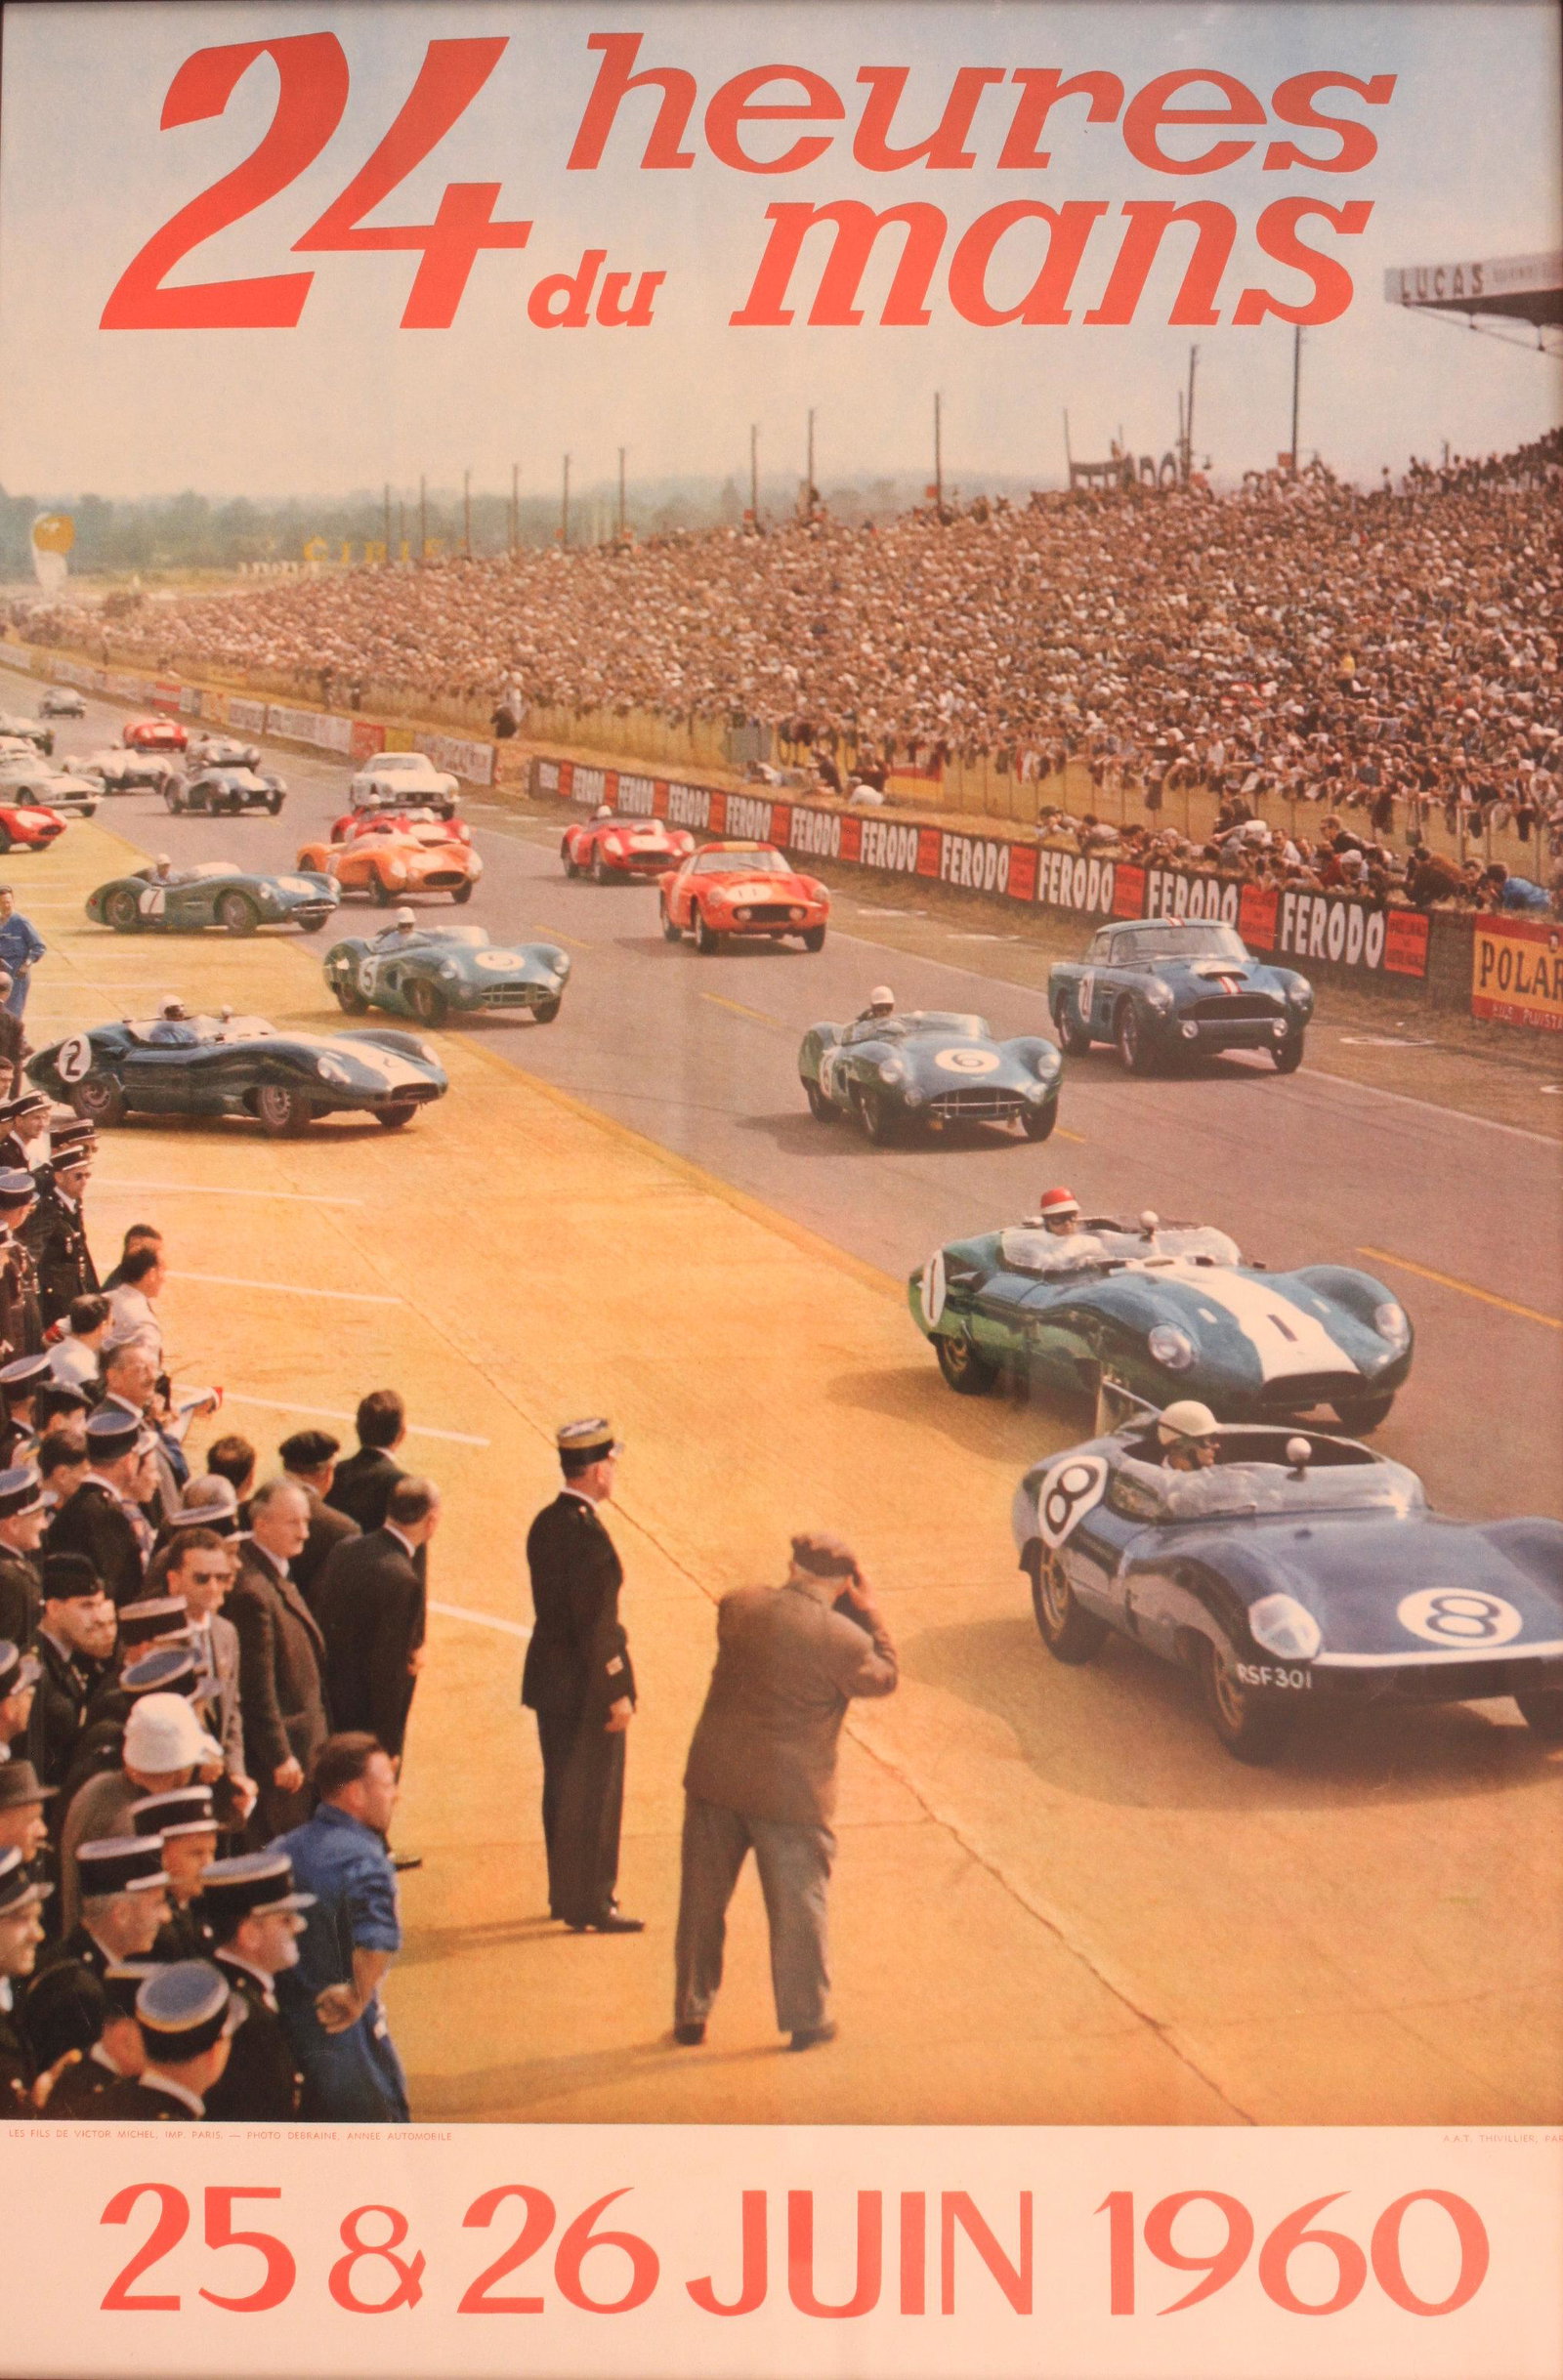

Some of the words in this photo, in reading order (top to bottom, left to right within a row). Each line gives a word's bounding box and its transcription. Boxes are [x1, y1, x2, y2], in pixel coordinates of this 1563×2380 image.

[99, 32, 532, 331] 24
[567, 33, 1396, 175] heures
[527, 249, 666, 329] du
[729, 200, 1373, 327] mans
[1400, 263, 1483, 300] LUCAS
[789, 807, 841, 857] FERODO
[860, 819, 918, 873] FERODO
[941, 833, 1010, 893] FERODO
[1038, 850, 1115, 914] FERODO
[1148, 870, 1238, 929] FERODO
[1281, 892, 1385, 969] FERODO
[63, 1039, 82, 1076] 2
[951, 1054, 984, 1068] 6
[928, 1258, 938, 1319] 1
[1267, 1314, 1298, 1342] 1
[1044, 1462, 1100, 1534] 8
[1425, 1594, 1502, 1639] 8
[8, 2128, 26, 2139] LES
[30, 2129, 51, 2139] FILS
[56, 2129, 68, 2139] DE
[73, 2129, 112, 2140] VICTOR
[246, 2131, 281, 2141] PHOTO
[387, 2132, 452, 2142] AUTOMOBILE
[100, 2183, 297, 2314] 25
[327, 2204, 426, 2315] &
[457, 2184, 660, 2315] 26
[686, 2190, 1033, 2319] JUIN
[1096, 2190, 1490, 2317] 1960
